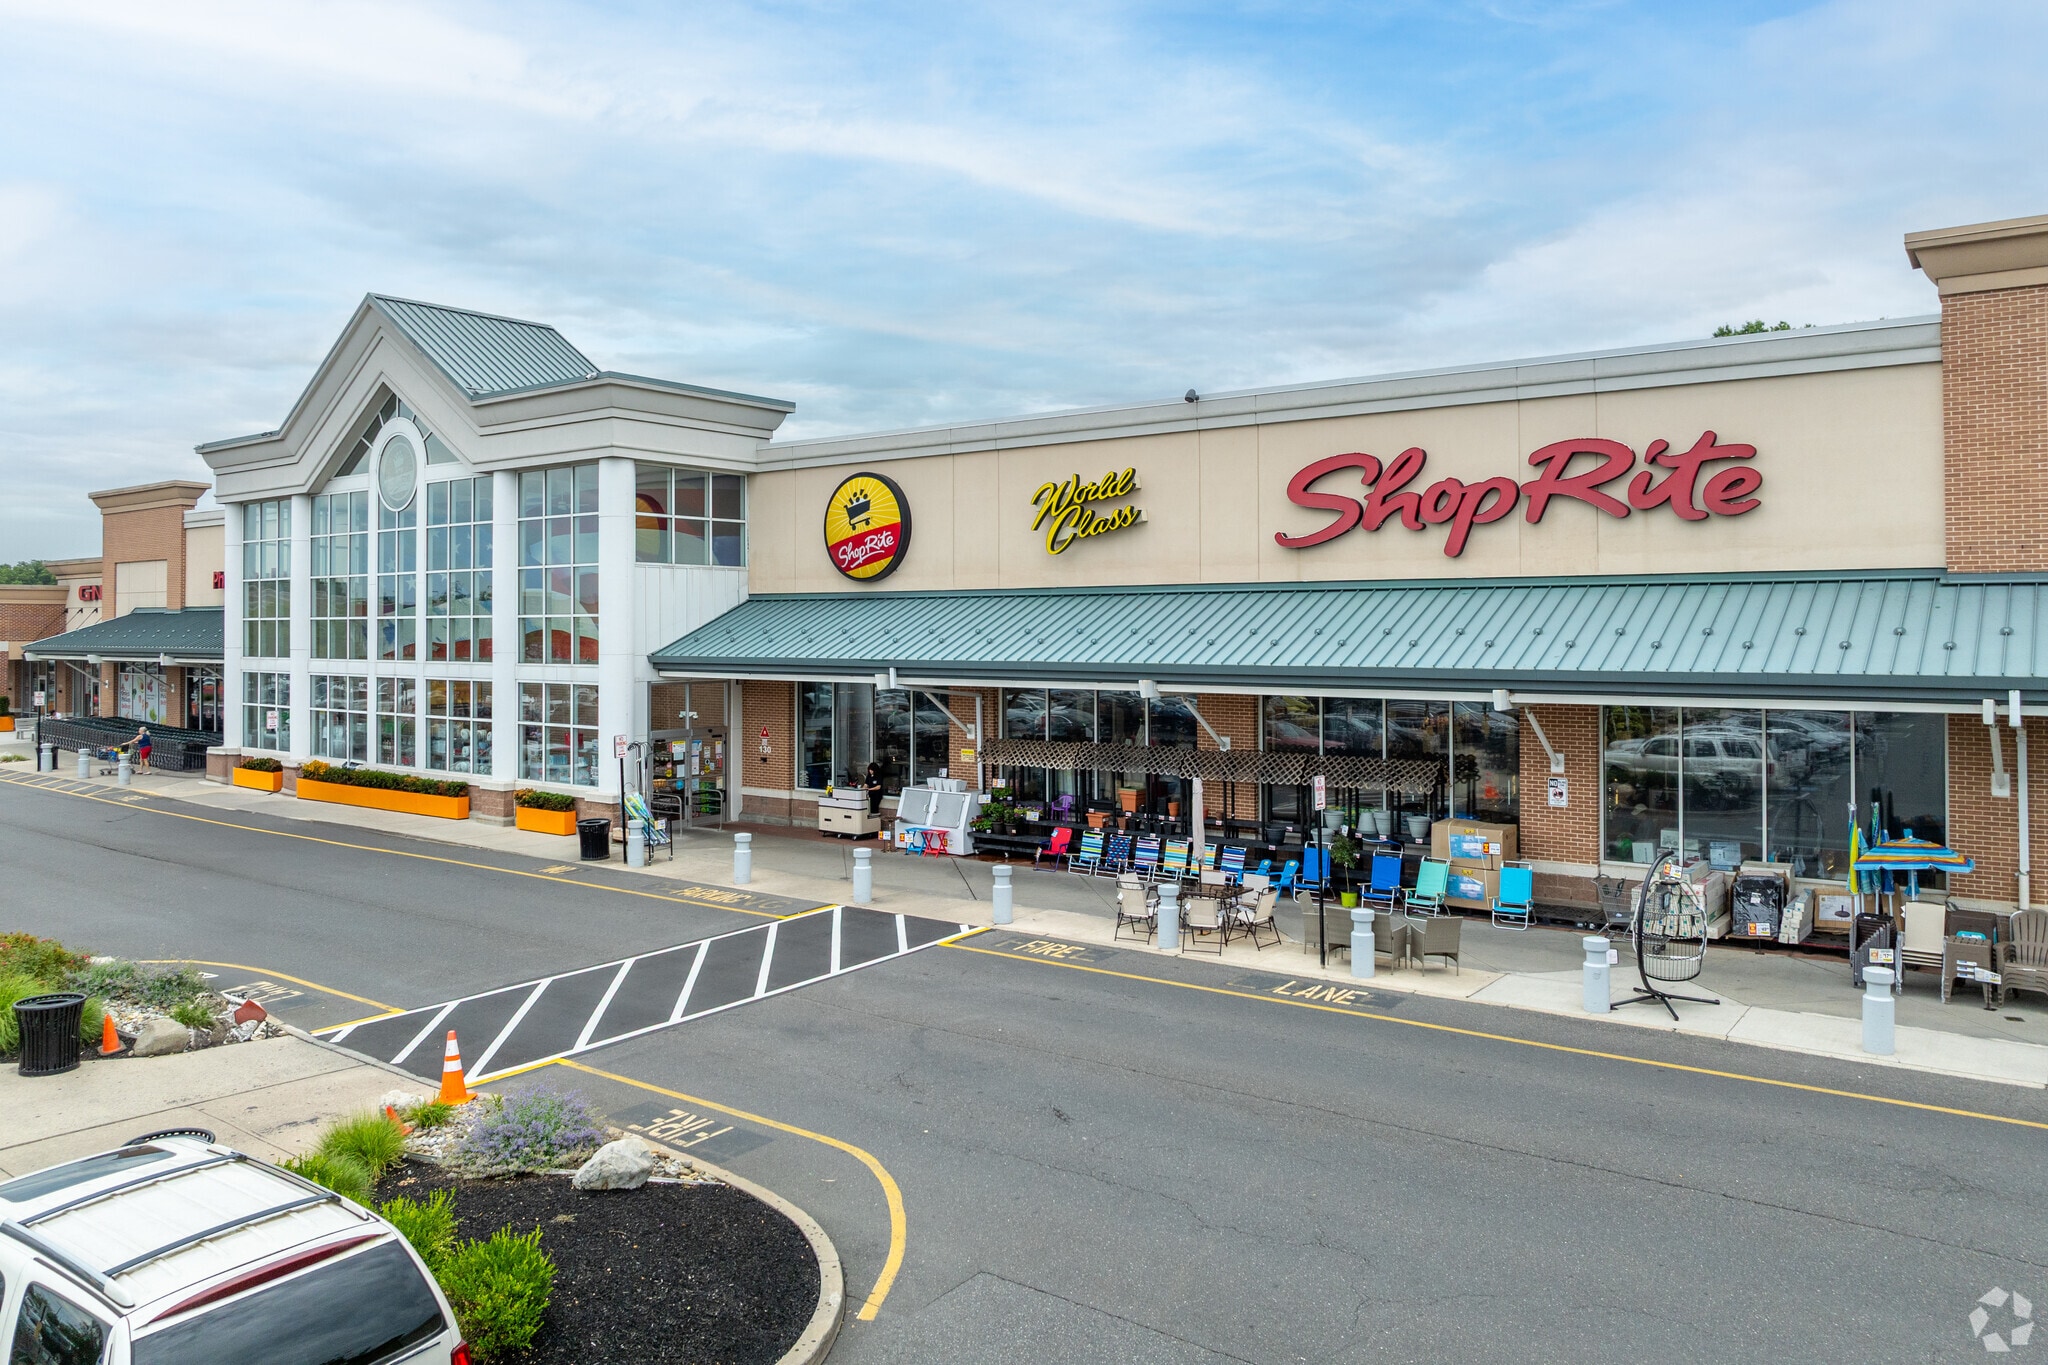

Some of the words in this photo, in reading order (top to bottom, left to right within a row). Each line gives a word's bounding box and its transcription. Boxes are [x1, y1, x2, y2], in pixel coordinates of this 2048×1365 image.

[1030, 466, 1137, 531] World
[1274, 429, 1764, 558] ShopRite
[1045, 504, 1143, 555] Class
[838, 530, 895, 568] ShopRite
[759, 745, 772, 754] 130
[1549, 779, 1558, 788] NO
[1013, 940, 1086, 959] FIRE
[1271, 980, 1370, 1006] LANE
[626, 1108, 734, 1148] FIRE
